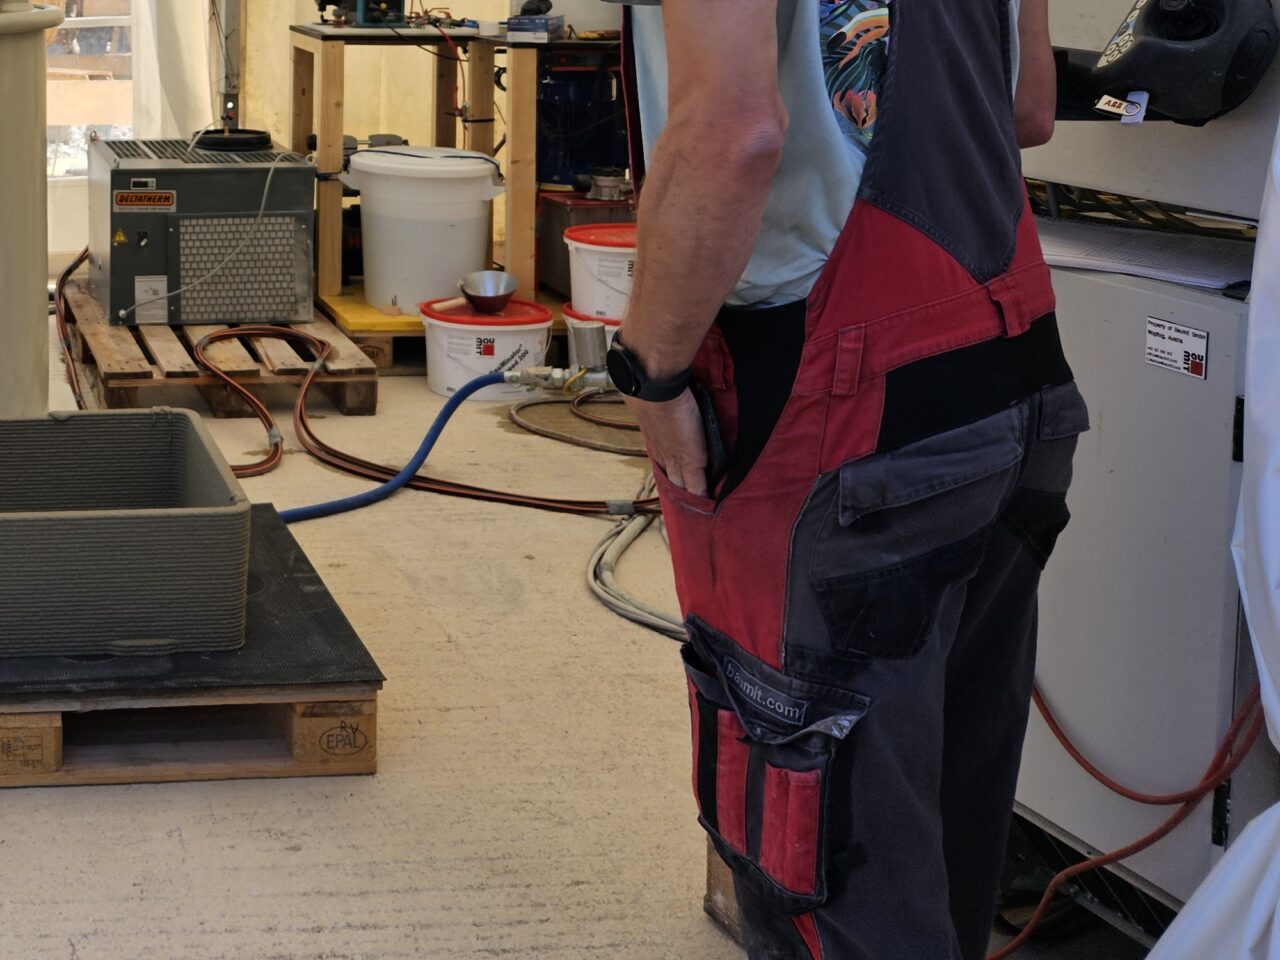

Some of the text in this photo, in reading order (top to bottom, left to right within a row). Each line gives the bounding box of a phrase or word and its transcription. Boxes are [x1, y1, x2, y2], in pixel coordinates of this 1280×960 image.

[1103, 100, 1123, 109] ABB
[118, 194, 171, 204] DELTATHERM
[326, 734, 361, 750] EPAL
